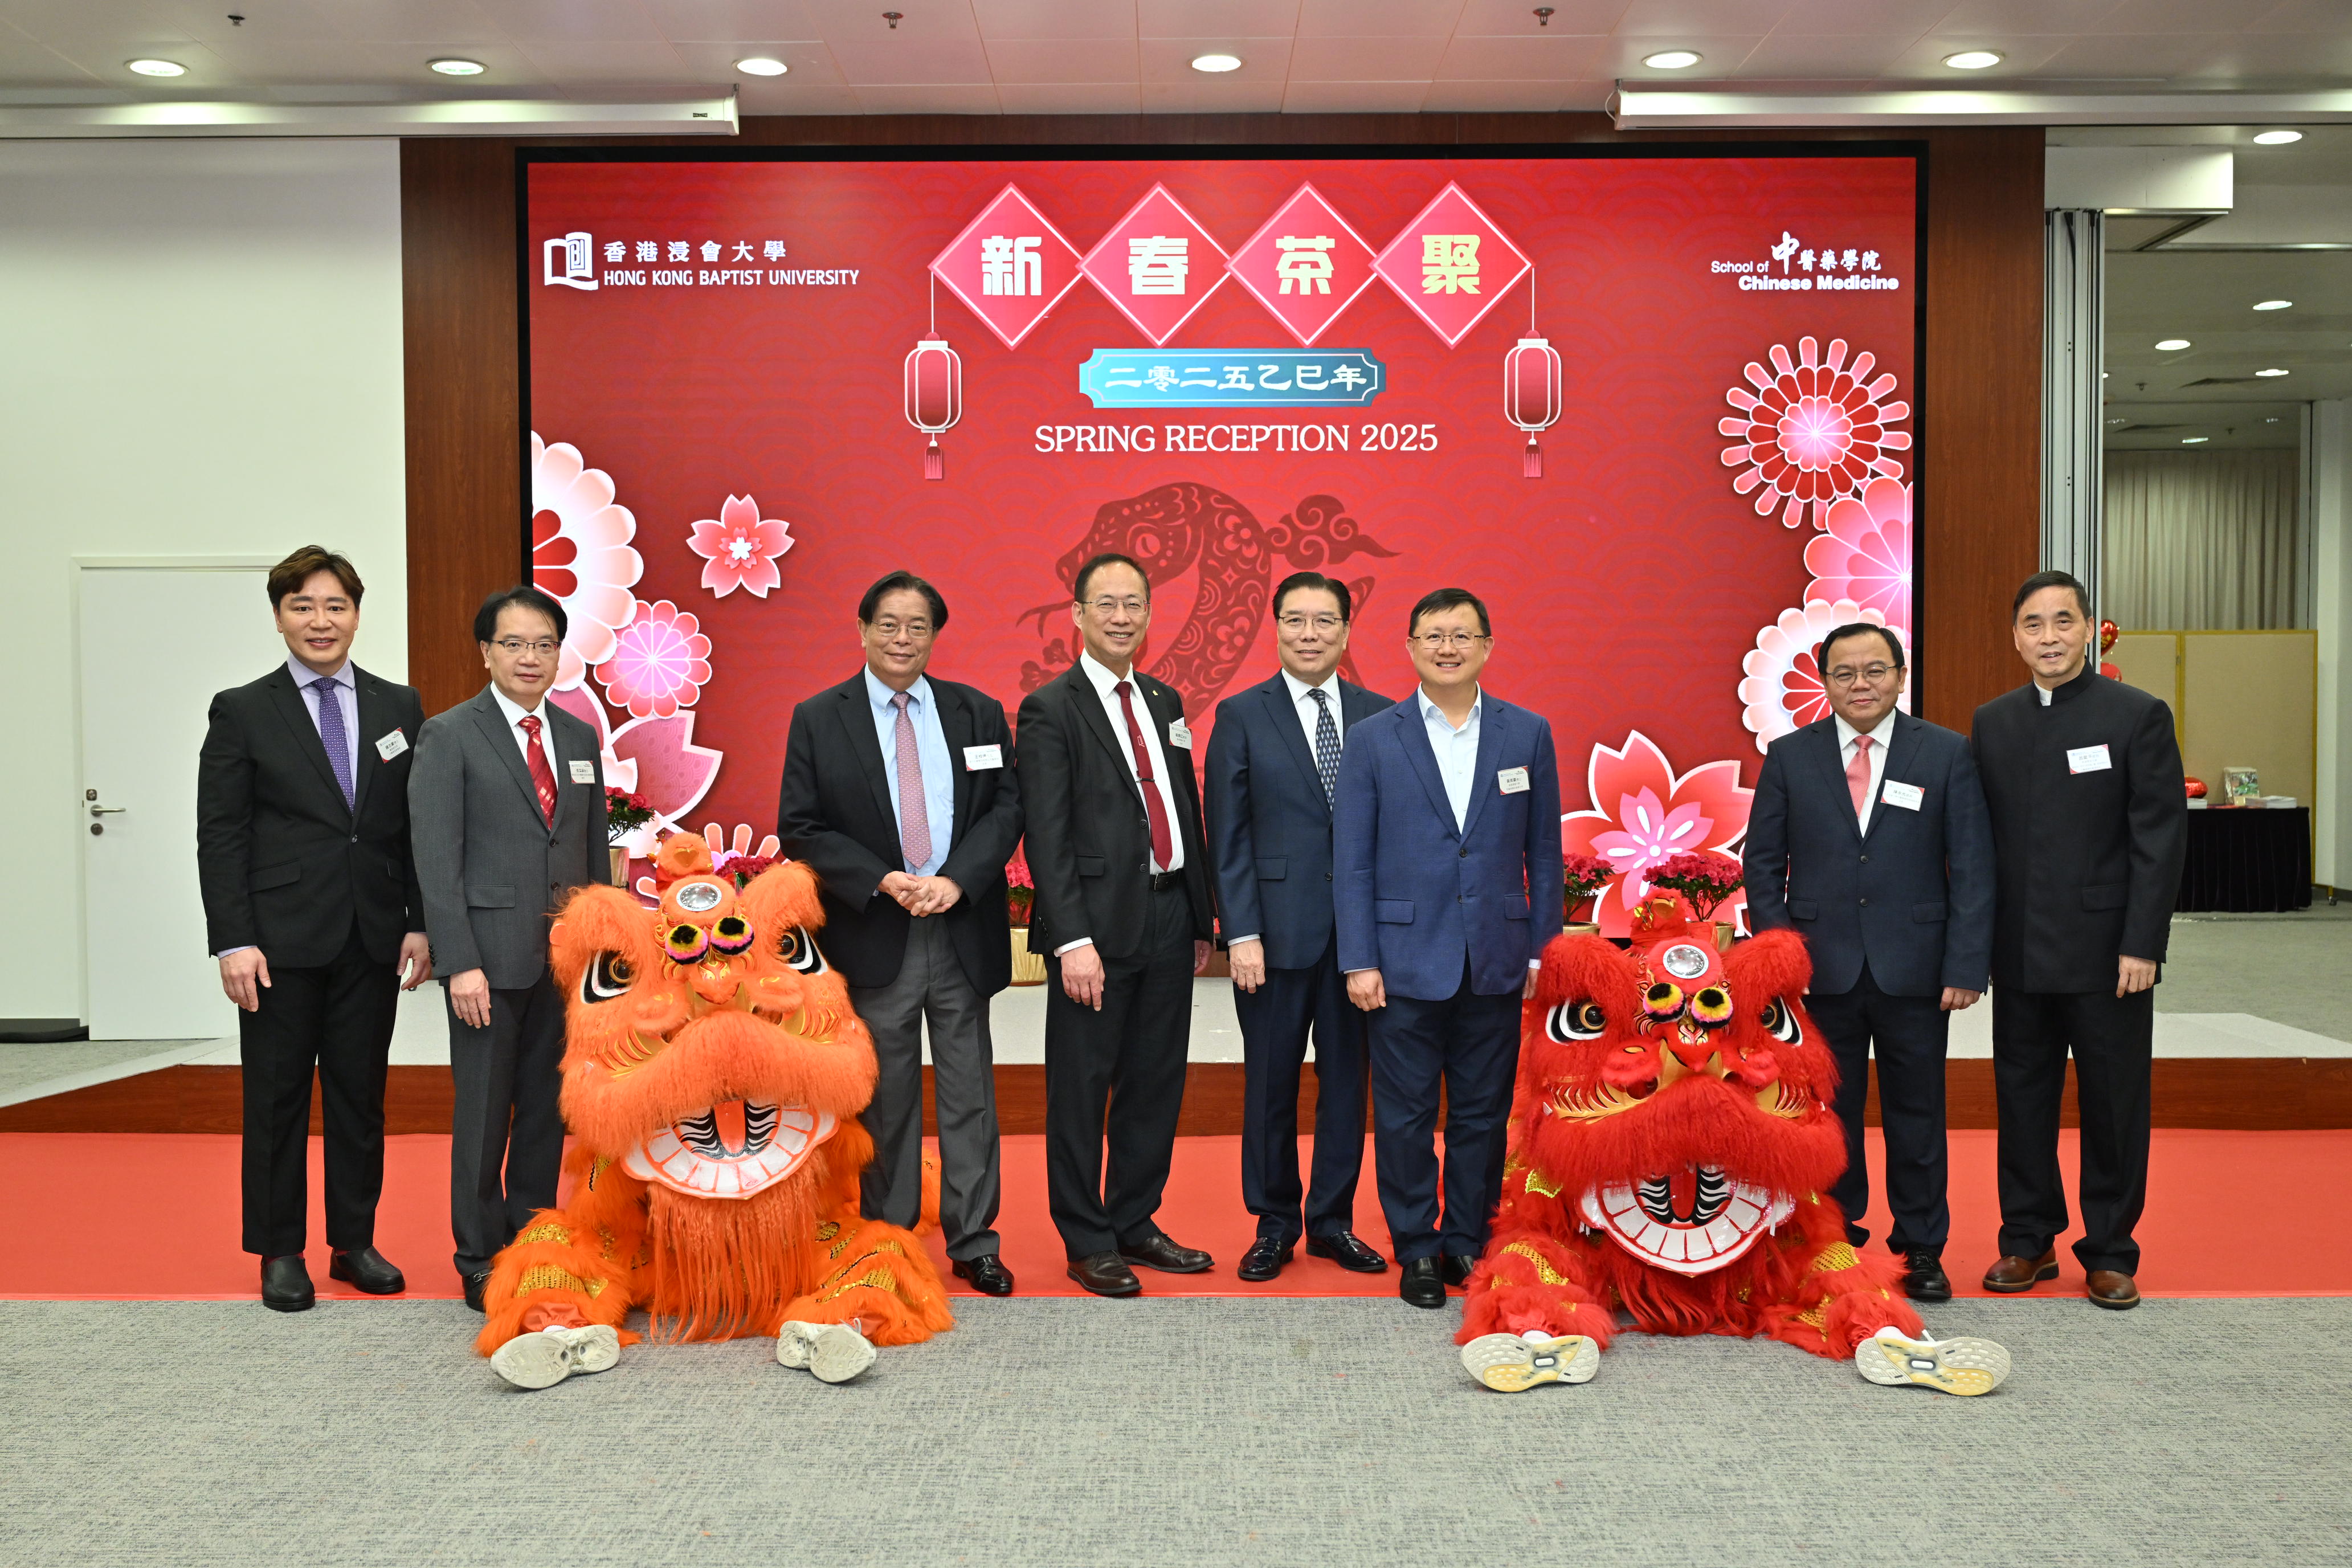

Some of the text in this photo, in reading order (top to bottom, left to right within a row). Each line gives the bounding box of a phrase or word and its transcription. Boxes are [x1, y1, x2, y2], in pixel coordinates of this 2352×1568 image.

[603, 240, 787, 263] 香港浸會大學
[1770, 231, 1881, 275] 中醫藥學院
[981, 234, 1481, 296] 新春茶聚
[1711, 260, 1769, 273] School of
[604, 270, 859, 286] HONG KONG BAPTIST UNIVERSITY
[1738, 275, 1899, 291] Chinese Medicine
[1104, 364, 1367, 392] 二零二五乙巳年
[1035, 423, 1438, 452] SPRING RECEPTION 2025
